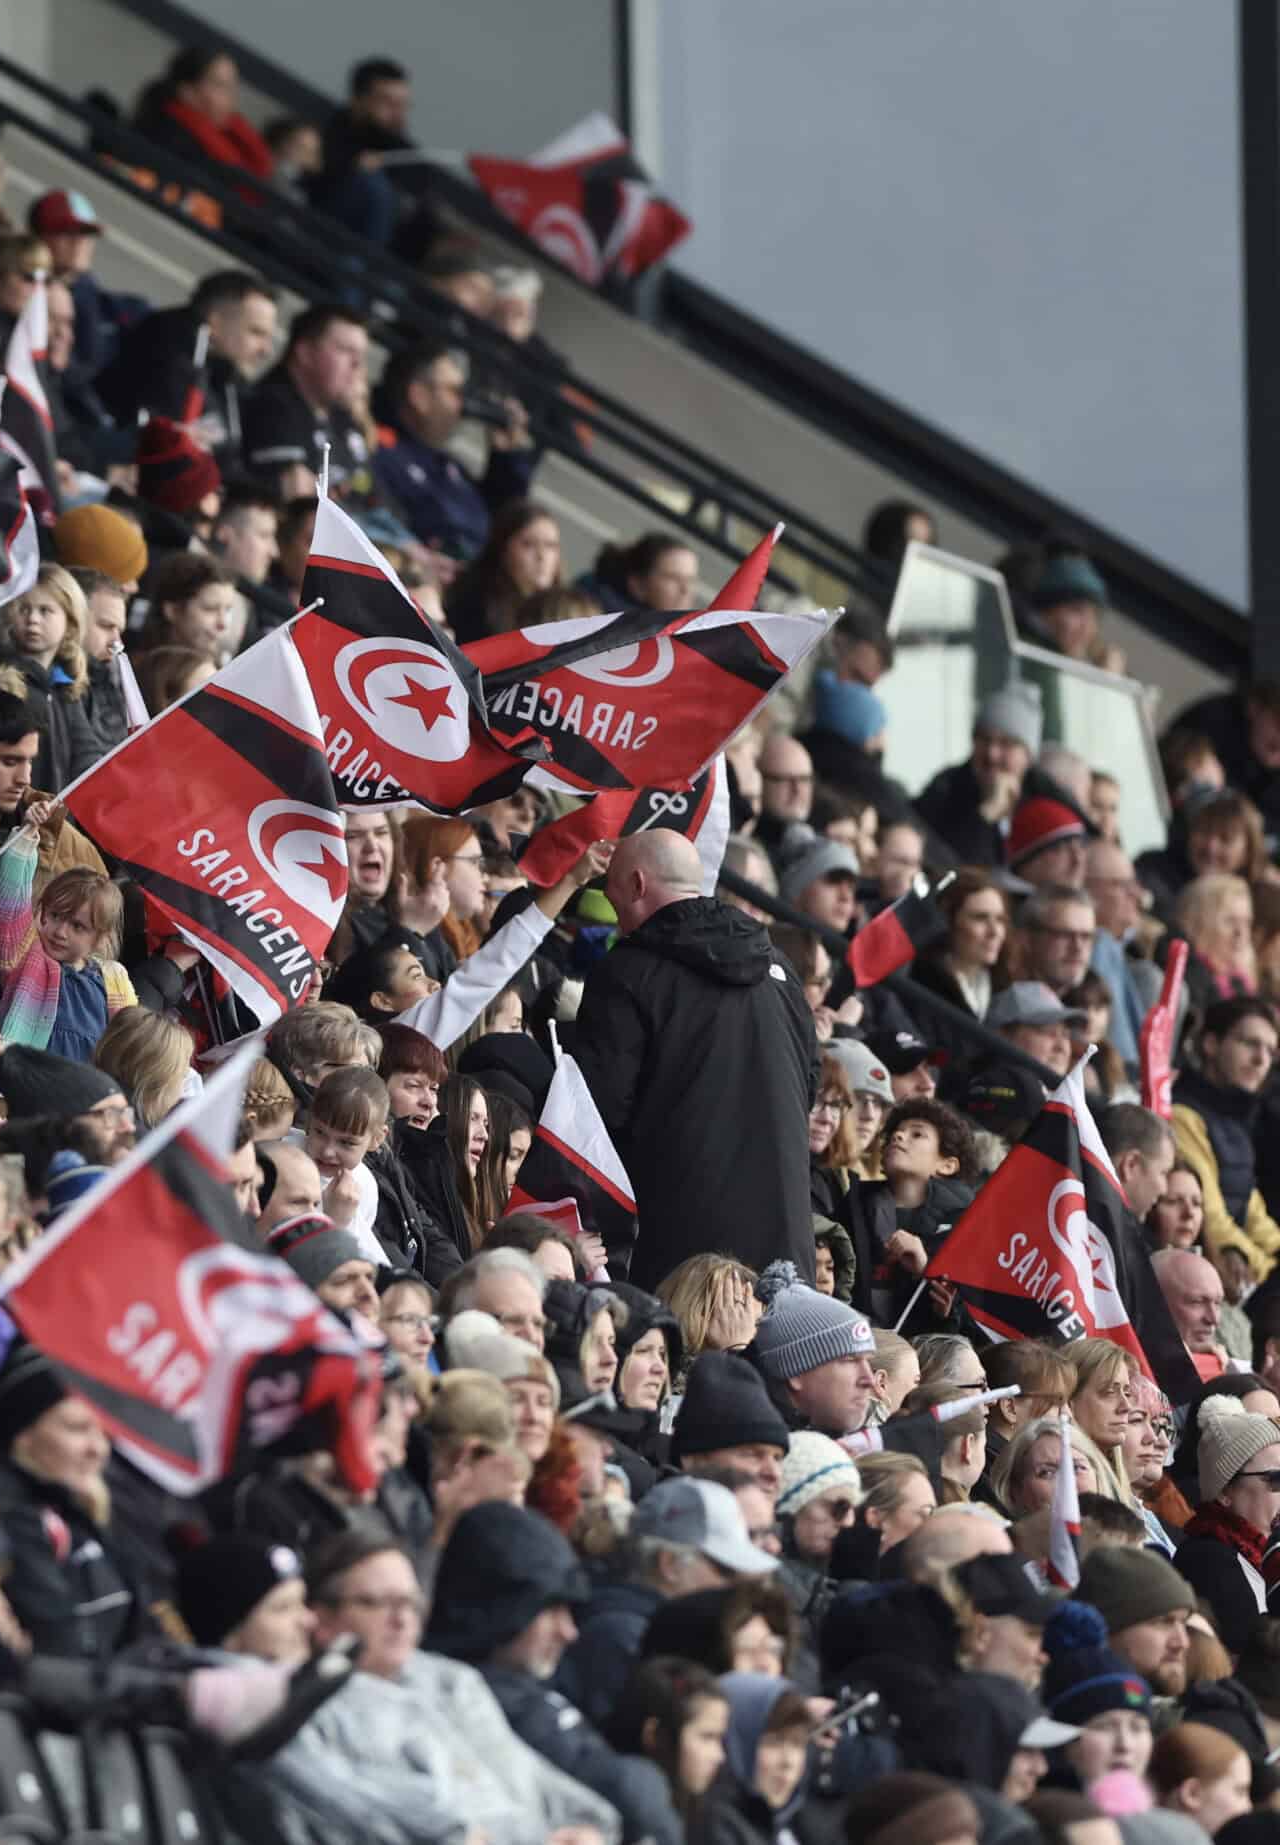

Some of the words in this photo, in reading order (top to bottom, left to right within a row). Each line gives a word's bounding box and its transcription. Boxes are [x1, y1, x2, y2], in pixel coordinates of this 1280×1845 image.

[320, 714, 410, 799] RACE
[177, 828, 313, 999] SARACENS
[998, 1232, 1087, 1340] SARACE
[106, 1301, 205, 1416] SAR
